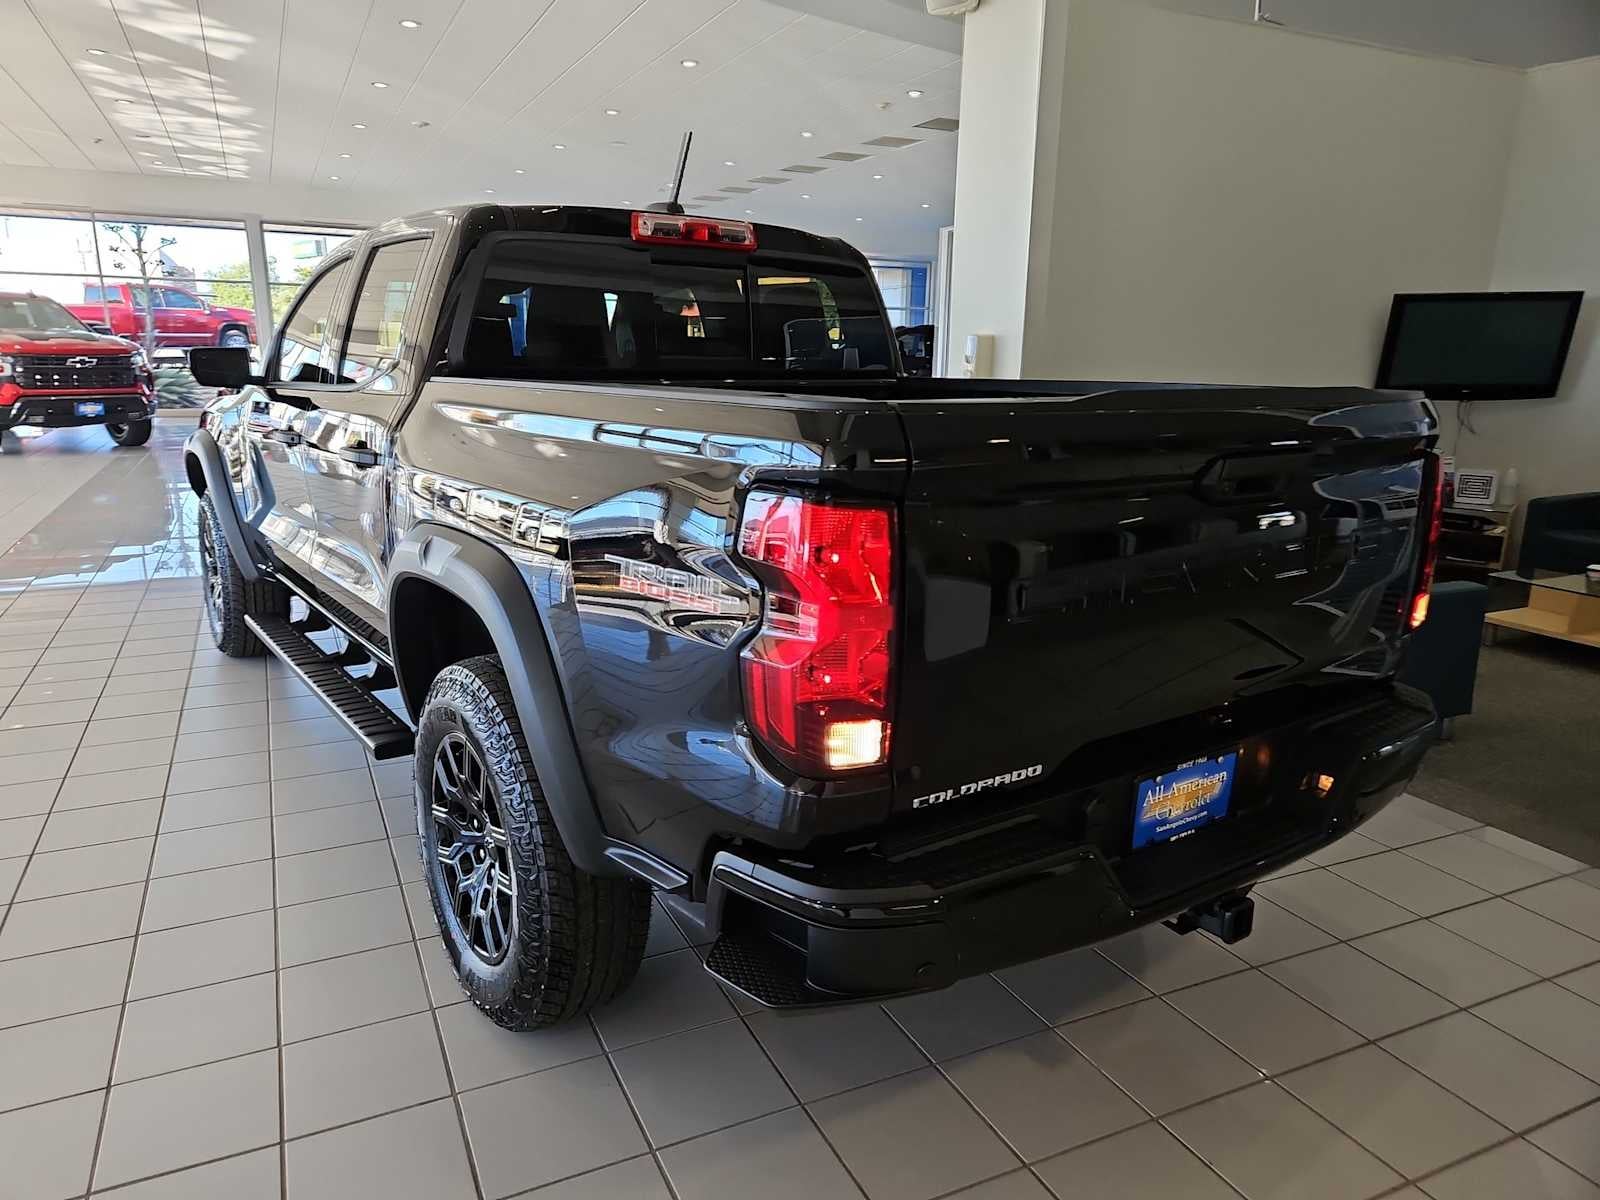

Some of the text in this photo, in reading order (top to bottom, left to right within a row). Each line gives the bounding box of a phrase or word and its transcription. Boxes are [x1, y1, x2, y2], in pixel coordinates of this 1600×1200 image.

[604, 553, 740, 604] TRAIL
[620, 576, 721, 614] BOSS
[912, 764, 1043, 809] COLORADO
[1143, 771, 1227, 808] All American
[1156, 793, 1211, 820] Chevrolet
